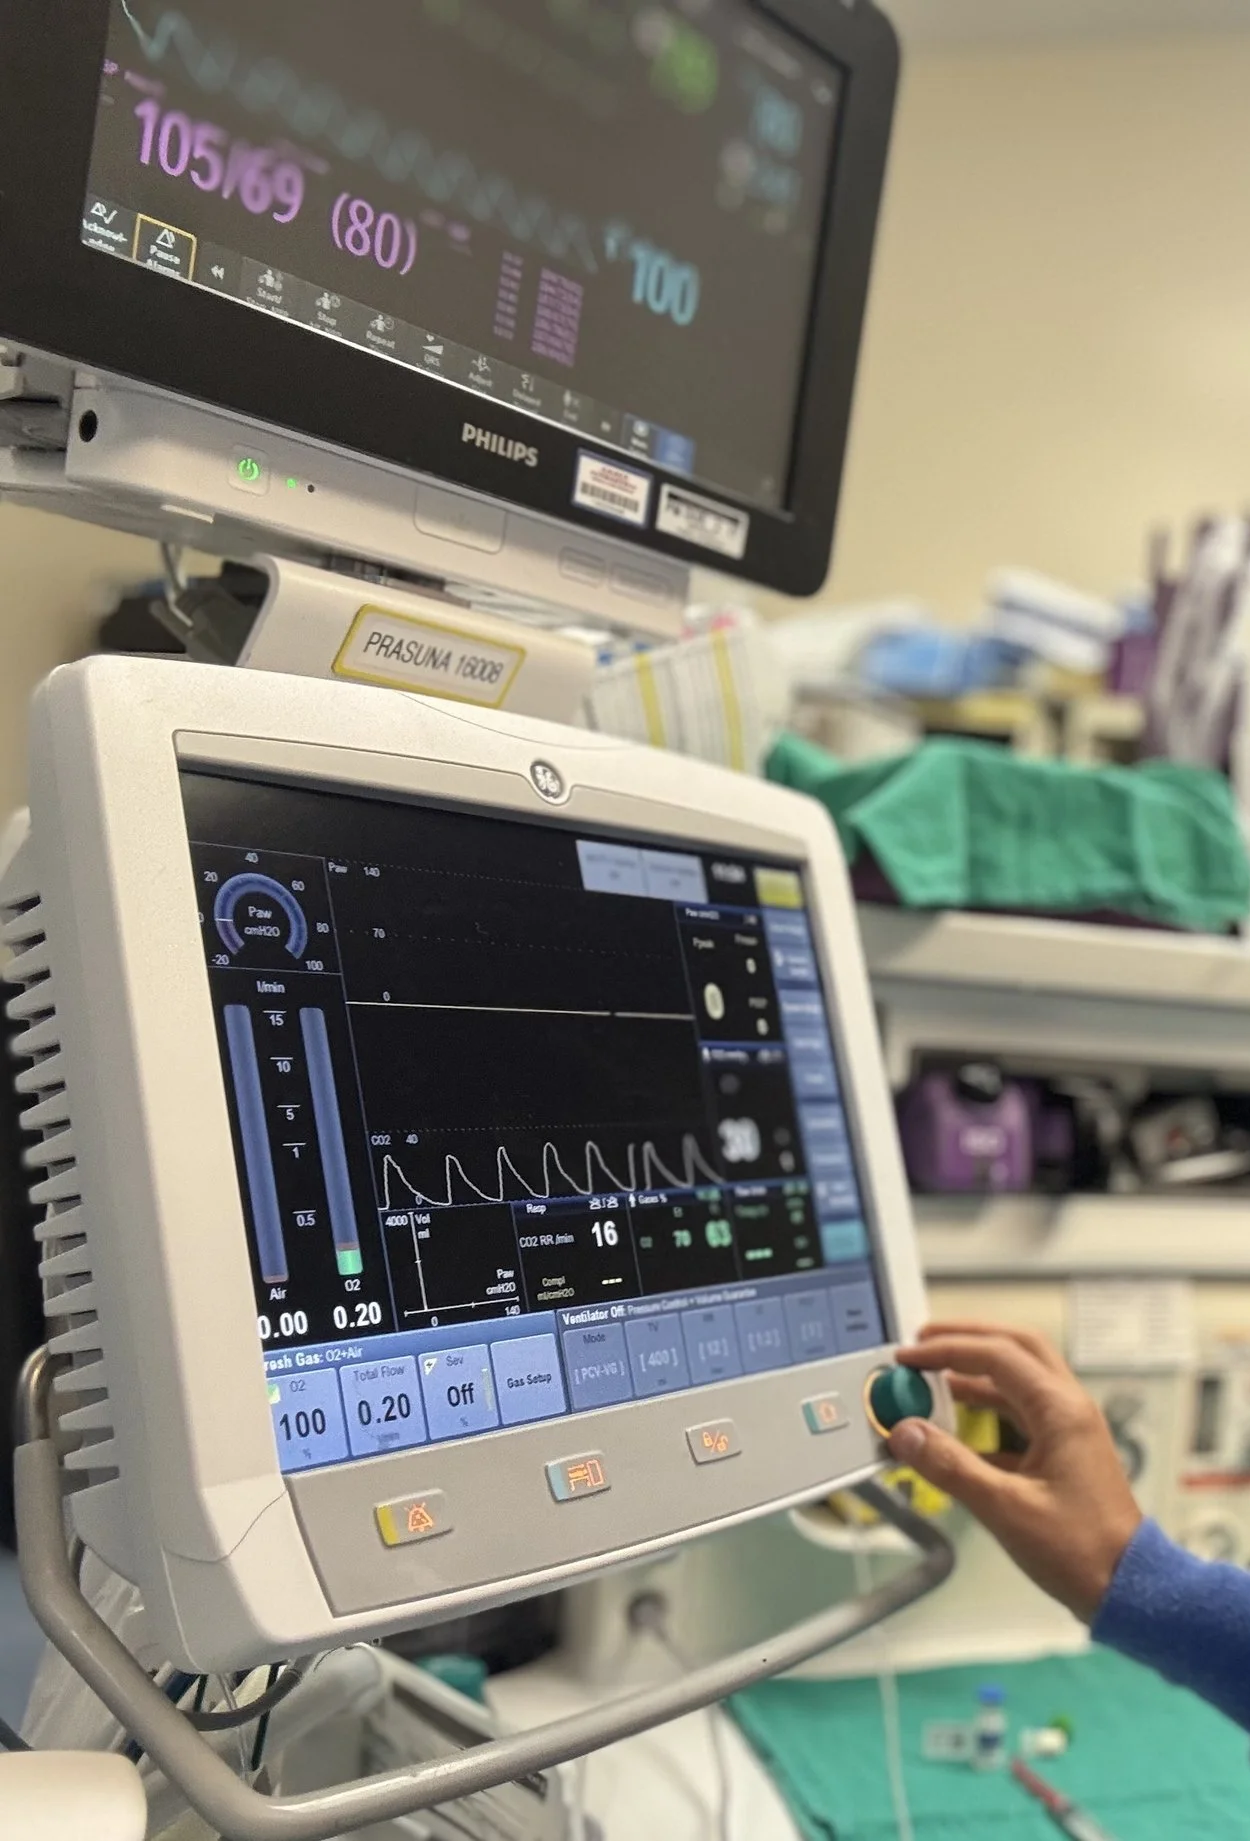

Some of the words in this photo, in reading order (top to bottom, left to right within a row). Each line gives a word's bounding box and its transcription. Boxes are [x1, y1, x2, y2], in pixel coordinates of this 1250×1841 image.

[134, 99, 305, 224] 105/69
[332, 192, 417, 275] (80)
[631, 243, 699, 325] 100
[461, 422, 539, 467] PHILIPS
[363, 631, 453, 673] PRASUNA
[455, 654, 505, 685] 16008
[328, 862, 348, 874] Paw
[364, 866, 380, 878] 140
[204, 871, 218, 883] 20
[292, 881, 305, 892] 60
[248, 906, 273, 919] Paw
[244, 926, 280, 938] cmH2O
[373, 927, 386, 939] 70
[212, 954, 230, 966] -20
[306, 960, 324, 972] 100
[256, 980, 286, 994] l/min
[383, 991, 391, 1002] 0
[269, 1014, 285, 1027] 15
[276, 1061, 292, 1074] 10
[286, 1108, 296, 1121] 5
[371, 1135, 391, 1146] CO2
[292, 1146, 300, 1159] 1
[296, 1214, 316, 1227] 0.5
[385, 1216, 408, 1227] 4000
[415, 1213, 431, 1225] Vol
[591, 1220, 619, 1247] 16
[519, 1236, 539, 1249] CO2
[540, 1234, 554, 1246] RR
[497, 1268, 515, 1279] Paw
[269, 1286, 288, 1301] Air
[486, 1282, 516, 1295] cmH2O
[333, 1301, 382, 1330] 0.20
[430, 1315, 439, 1327] 0
[562, 1308, 609, 1326] Ventilator
[583, 1332, 606, 1345] Mode
[353, 1367, 379, 1383] Total
[381, 1364, 406, 1379] Flow
[289, 1380, 306, 1393] O2
[507, 1377, 526, 1389] Gas
[527, 1373, 553, 1387] Setup
[447, 1382, 475, 1408] Off
[358, 1392, 412, 1426] 0.20
[279, 1407, 327, 1441] 100
